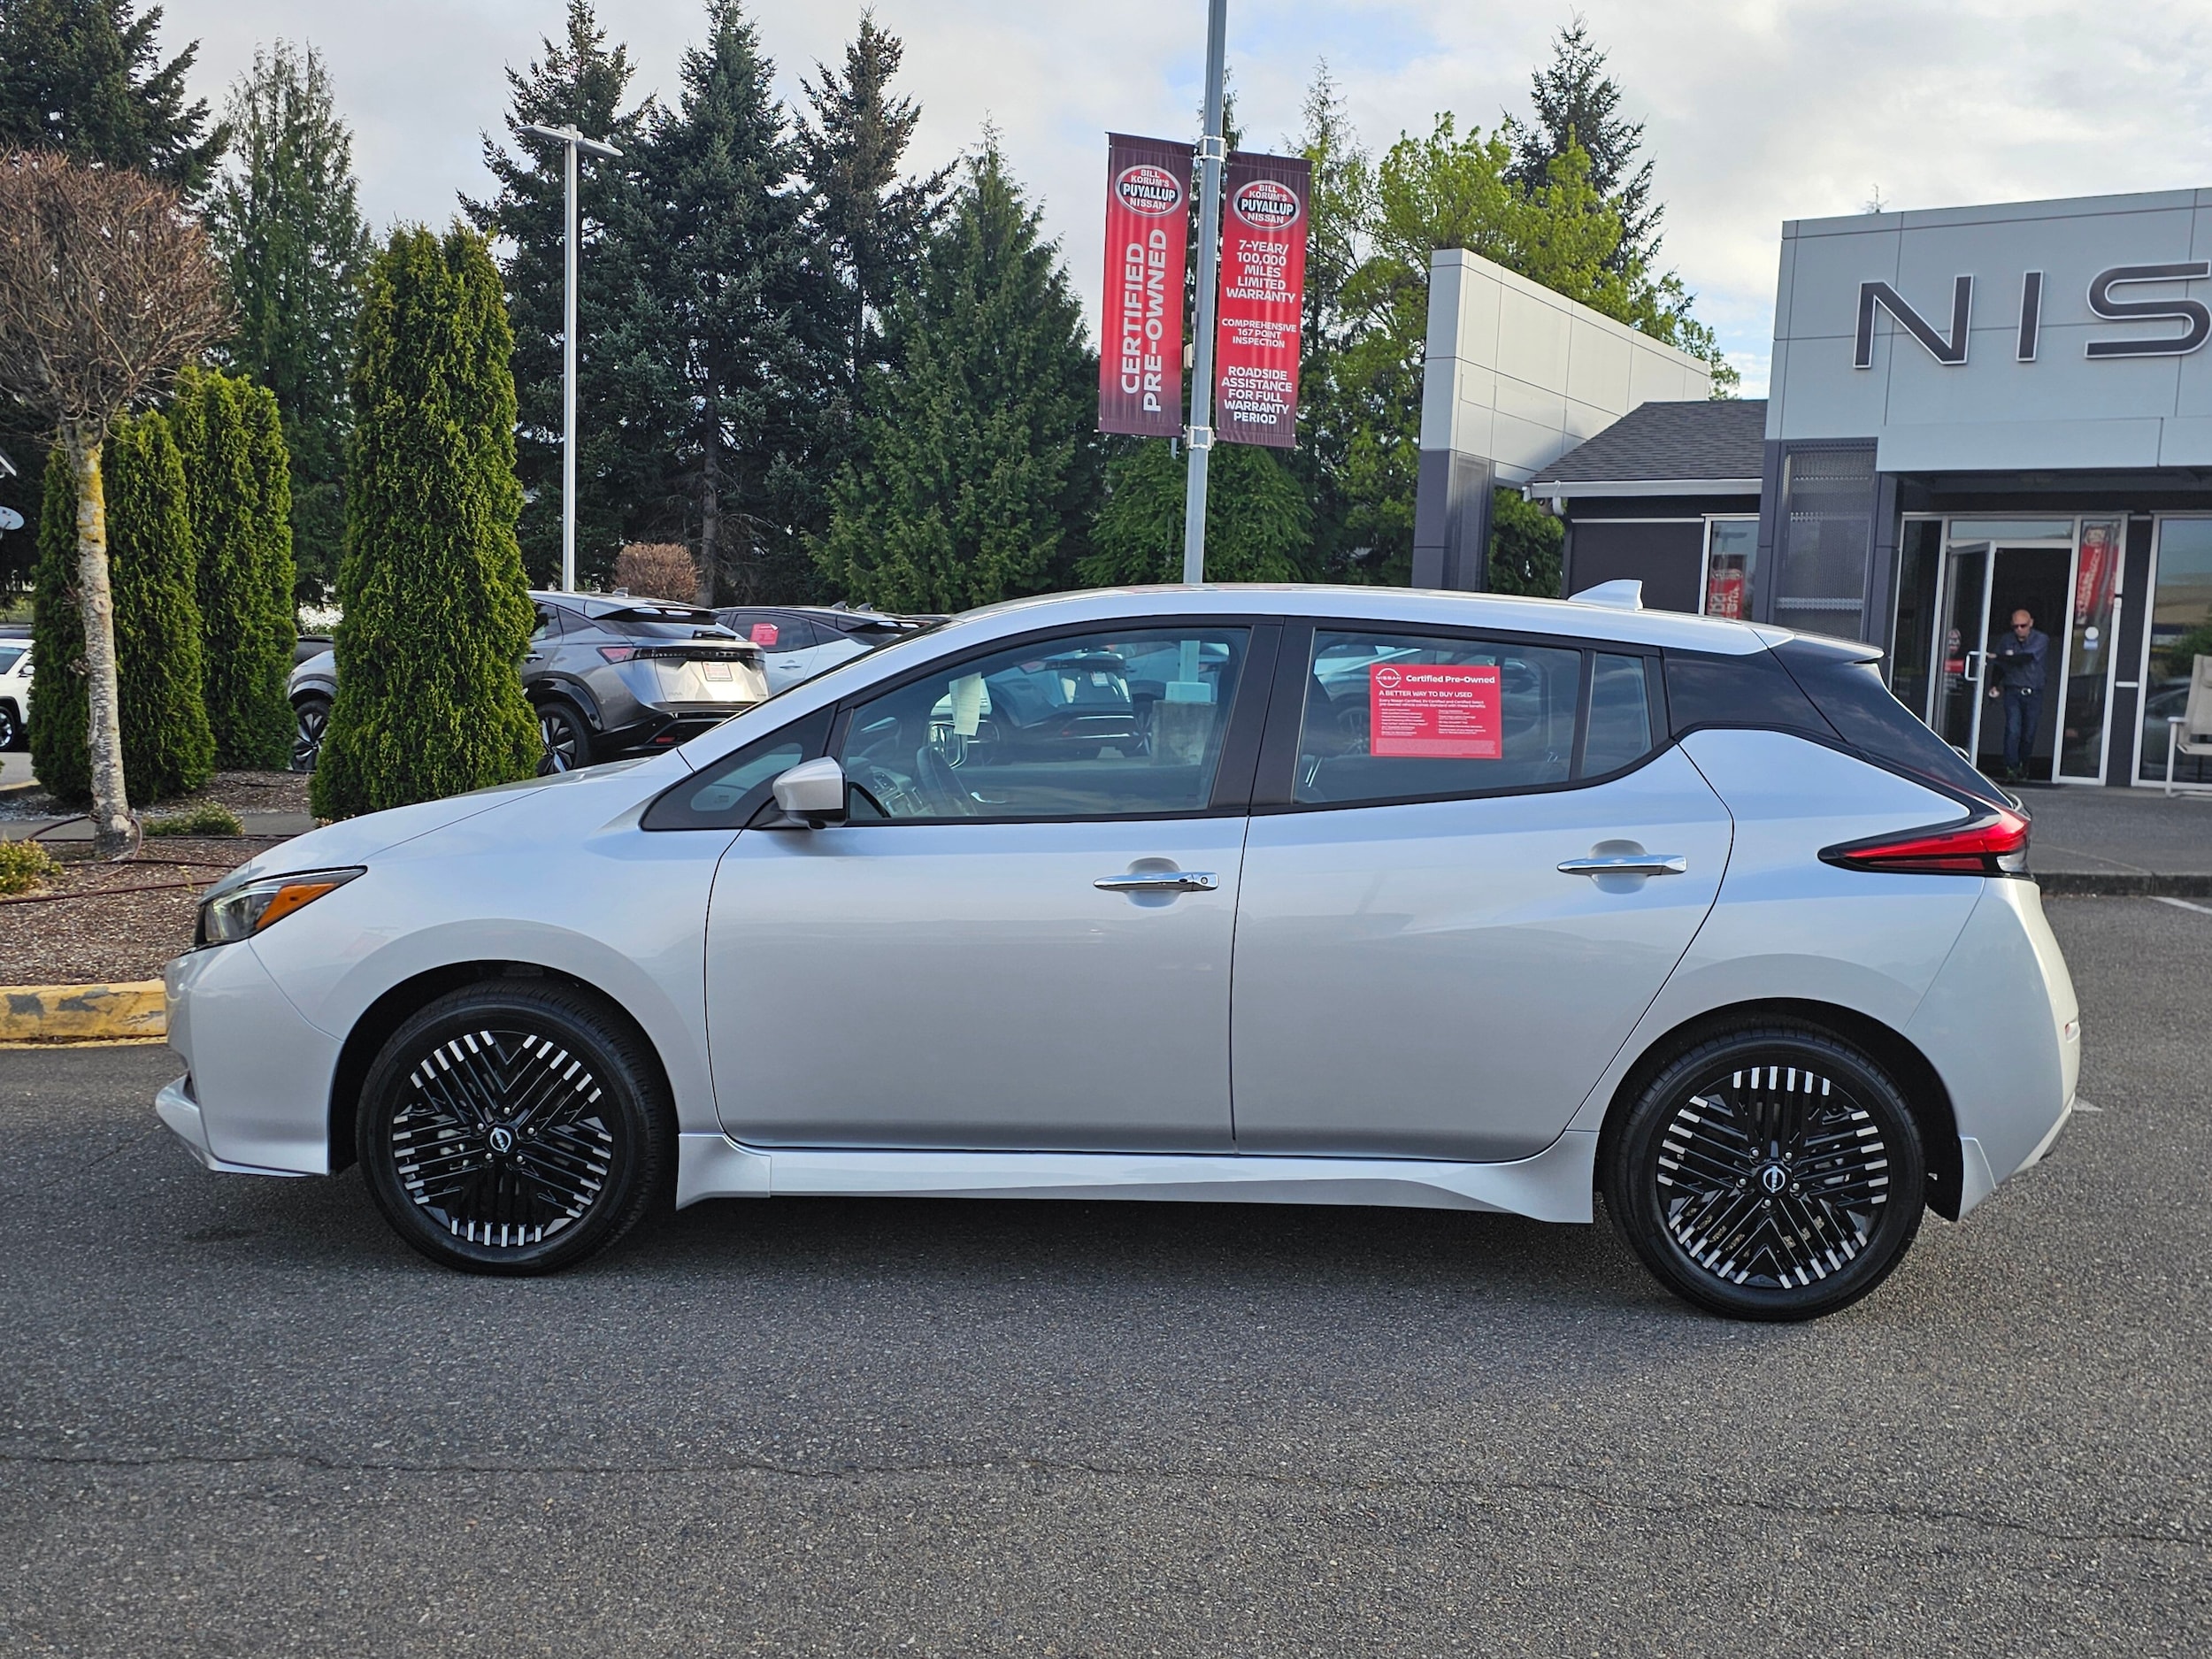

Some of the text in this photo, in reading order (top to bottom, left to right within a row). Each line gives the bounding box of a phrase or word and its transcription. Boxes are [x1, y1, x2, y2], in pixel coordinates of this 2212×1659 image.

[1131, 175, 1170, 188] KORUM'S
[1141, 169, 1160, 179] BILL
[1123, 183, 1176, 202] PUYALLUP
[1249, 190, 1287, 202] KORUM'S
[1259, 184, 1277, 193] BILL
[1130, 197, 1166, 211] NISSAN
[1241, 198, 1294, 216] PUYALLUP
[1248, 212, 1284, 224] NISSAN
[1239, 240, 1289, 256] 7-YEAR/
[1237, 251, 1286, 266] 100,000
[1244, 265, 1281, 278] MILES
[1237, 275, 1286, 290] LIMITED
[1225, 287, 1296, 303] WARRANTY
[1121, 242, 1145, 395] CERTIFIED
[1143, 228, 1167, 412] PRE-OWNED
[1853, 259, 2212, 369] NIS
[1222, 318, 1297, 333] COMPREHENSIVE
[1238, 327, 1282, 340] 167 POINT
[1233, 335, 1286, 349] INSPECTION
[1228, 365, 1288, 380] ROADSIDE
[1221, 376, 1293, 393] ASSISTANCE
[1228, 388, 1283, 403] FOR FULL
[1224, 399, 1290, 415] WARRANTY
[1233, 411, 1278, 425] PERIOD
[1405, 674, 1495, 684] Certified Pre-Owned
